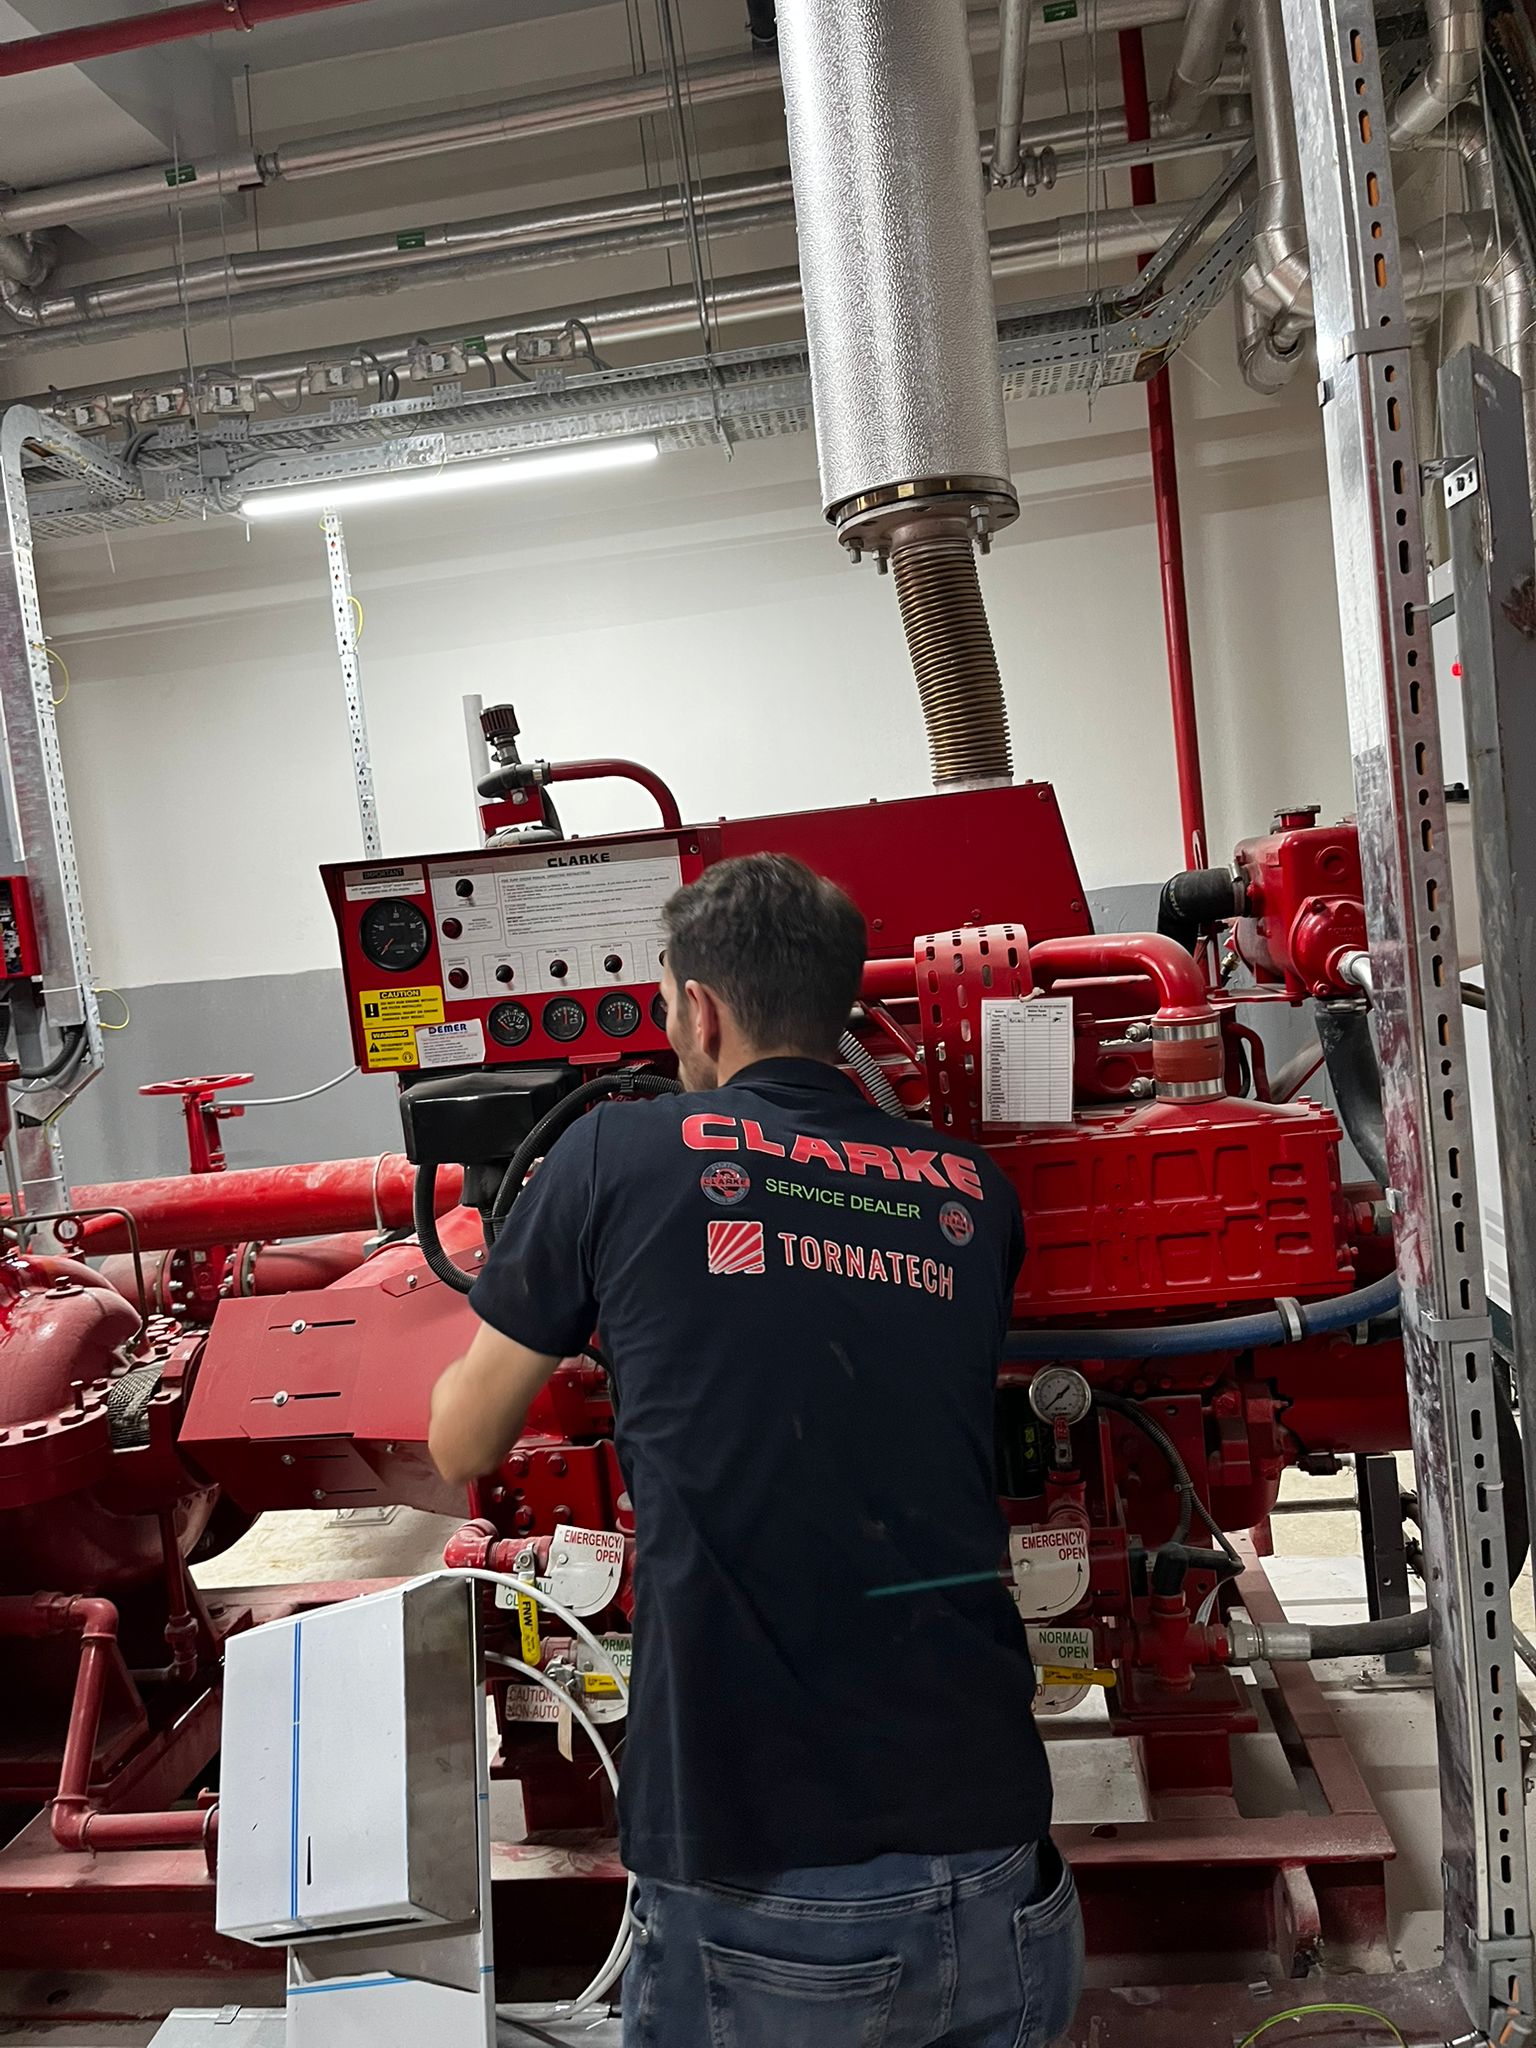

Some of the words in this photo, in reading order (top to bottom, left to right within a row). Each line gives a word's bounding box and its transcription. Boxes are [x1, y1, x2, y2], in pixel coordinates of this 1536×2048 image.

[547, 852, 611, 867] CLARKE
[364, 868, 403, 879] IMPORTANT
[381, 990, 418, 999] CAUTION
[428, 1023, 468, 1034] DEMER
[681, 1113, 984, 1200] CLARKE
[765, 1177, 845, 1207] SERVICE
[850, 1195, 922, 1219] DEALER
[777, 1232, 954, 1301] TORNATECH
[564, 1529, 623, 1549] EMERGENCY/
[1021, 1531, 1085, 1550] EMERGENCY/
[595, 1549, 621, 1564] OPEN
[1058, 1547, 1086, 1561] OPEN
[522, 1601, 534, 1628] FNW
[1039, 1631, 1088, 1644] NORMAL/
[1058, 1646, 1090, 1659] OPEN
[612, 1654, 632, 1667] OPE
